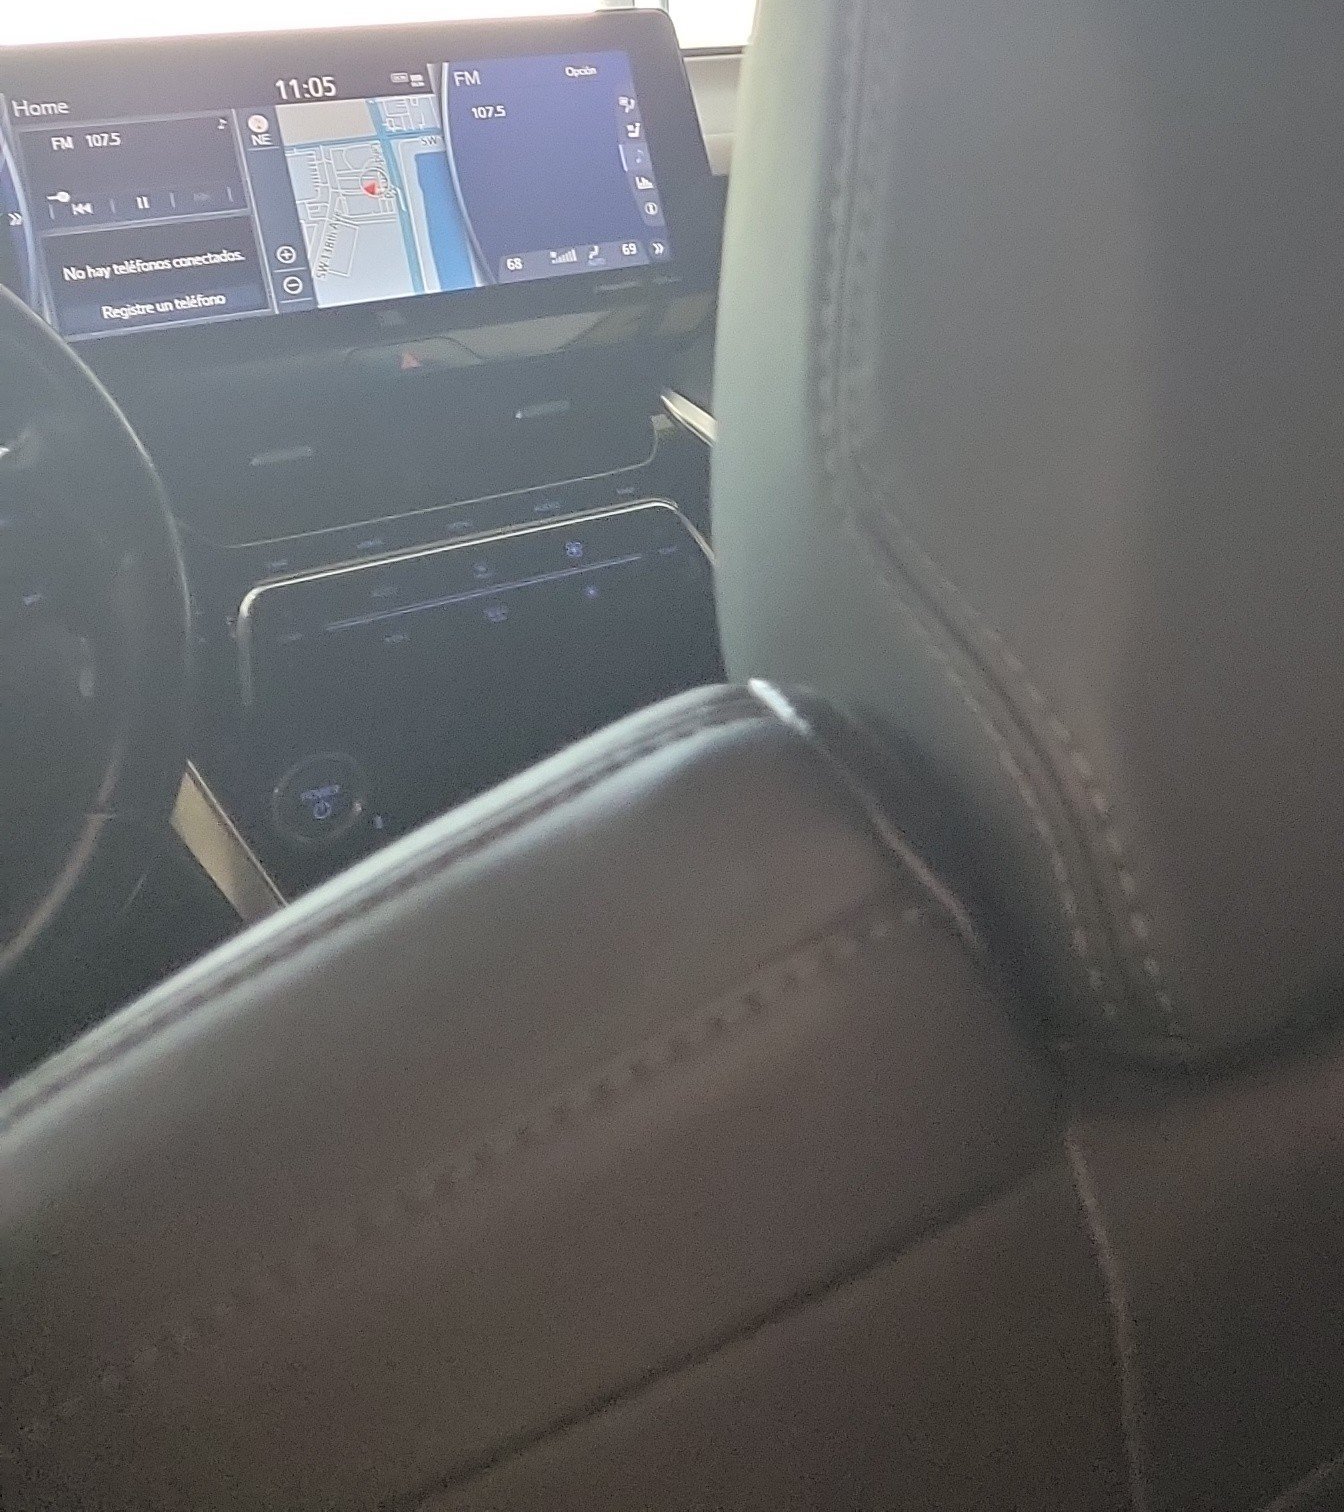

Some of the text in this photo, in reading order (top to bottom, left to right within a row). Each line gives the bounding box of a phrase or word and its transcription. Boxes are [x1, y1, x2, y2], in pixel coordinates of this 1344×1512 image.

[453, 69, 482, 87] FM
[275, 76, 337, 100] 11:05
[11, 99, 70, 118] Home
[471, 104, 507, 119] 107.5
[51, 135, 75, 151] FM
[250, 133, 273, 147] NE
[420, 135, 438, 148] SW
[621, 242, 637, 256] 69
[62, 267, 86, 281] No
[86, 264, 111, 279] hay
[112, 257, 173, 275] teléfonos
[506, 257, 524, 271] 68
[101, 293, 227, 320] Registre un teléfono
